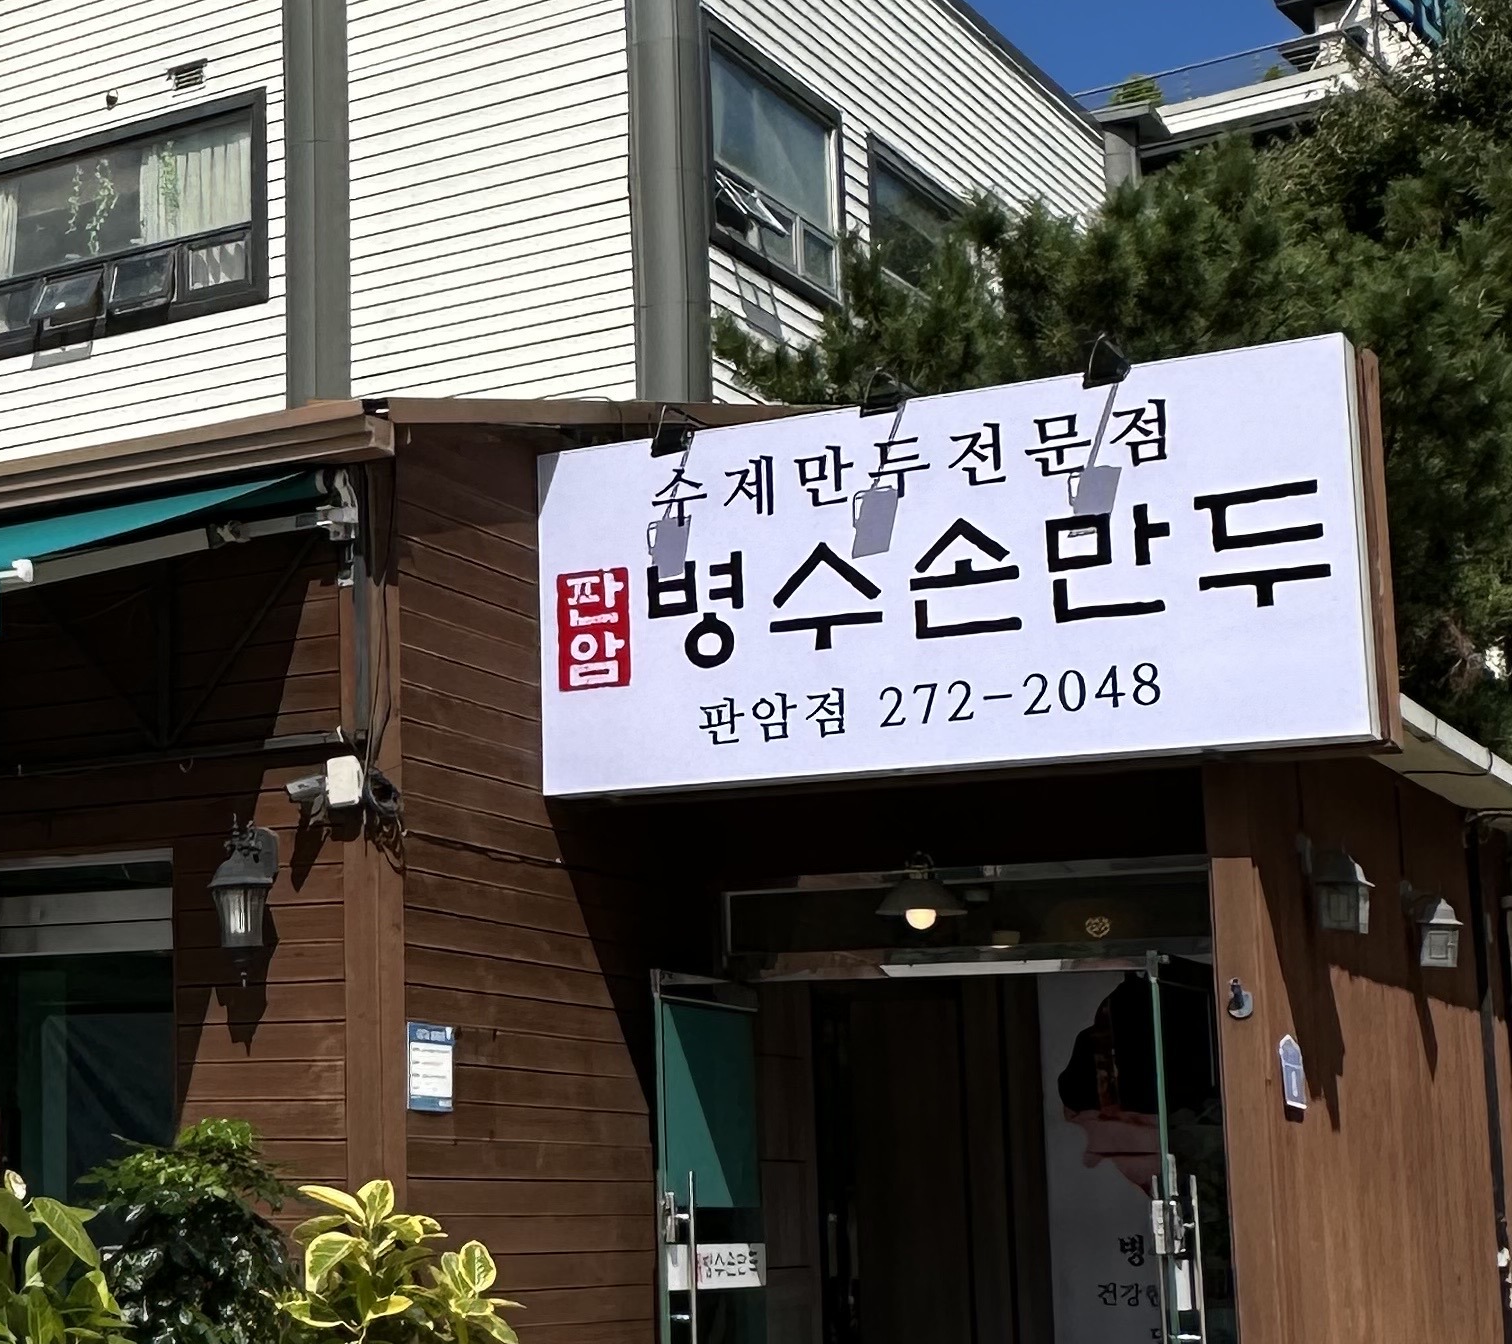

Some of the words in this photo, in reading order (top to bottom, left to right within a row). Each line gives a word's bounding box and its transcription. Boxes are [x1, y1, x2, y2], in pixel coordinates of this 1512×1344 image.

[651, 398, 1169, 528] 수제만두전문점
[566, 573, 625, 686] 판암
[646, 479, 1333, 669] 병수손만두
[698, 687, 847, 747] 판암점
[879, 662, 1162, 728] 272-2048
